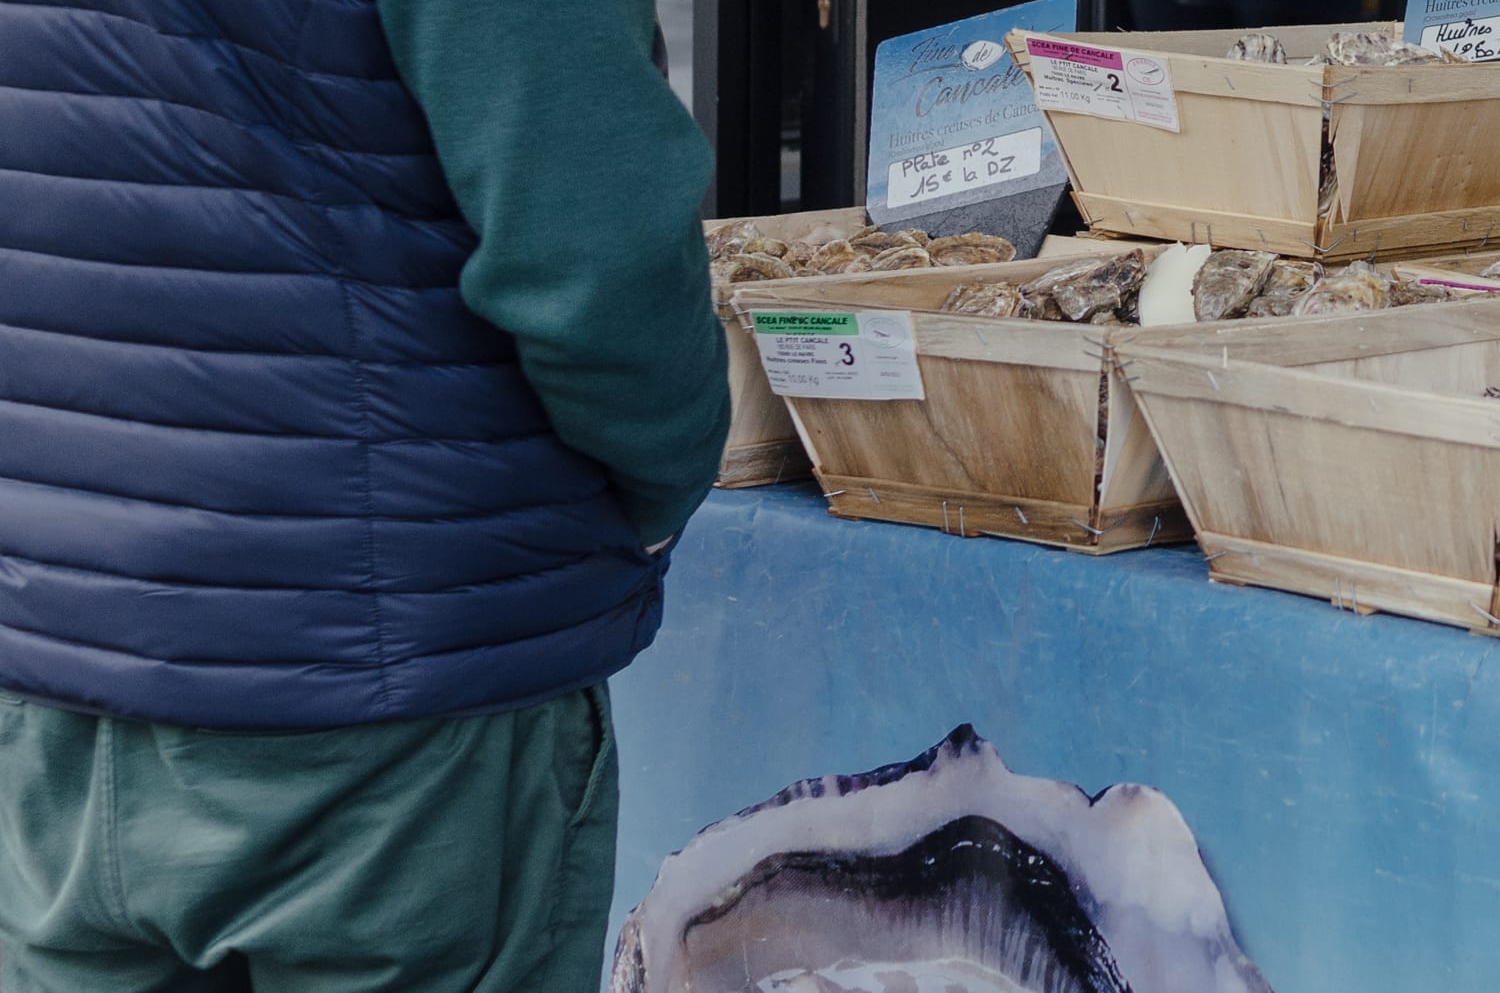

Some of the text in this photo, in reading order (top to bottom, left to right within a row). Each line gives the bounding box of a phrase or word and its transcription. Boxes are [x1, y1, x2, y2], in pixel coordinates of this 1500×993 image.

[910, 31, 992, 74] Fine de
[1032, 40, 1050, 49] SCEA
[1052, 44, 1068, 52] FINE
[1081, 48, 1114, 60] CANCALE
[915, 65, 1025, 118] Cancale
[1107, 73, 1123, 93] 2
[936, 114, 982, 137] creuses
[984, 109, 1001, 126] de
[1002, 102, 1041, 121] Canca
[756, 316, 777, 325] SCEA
[810, 317, 848, 325] CANCALE
[839, 342, 854, 366] 3
